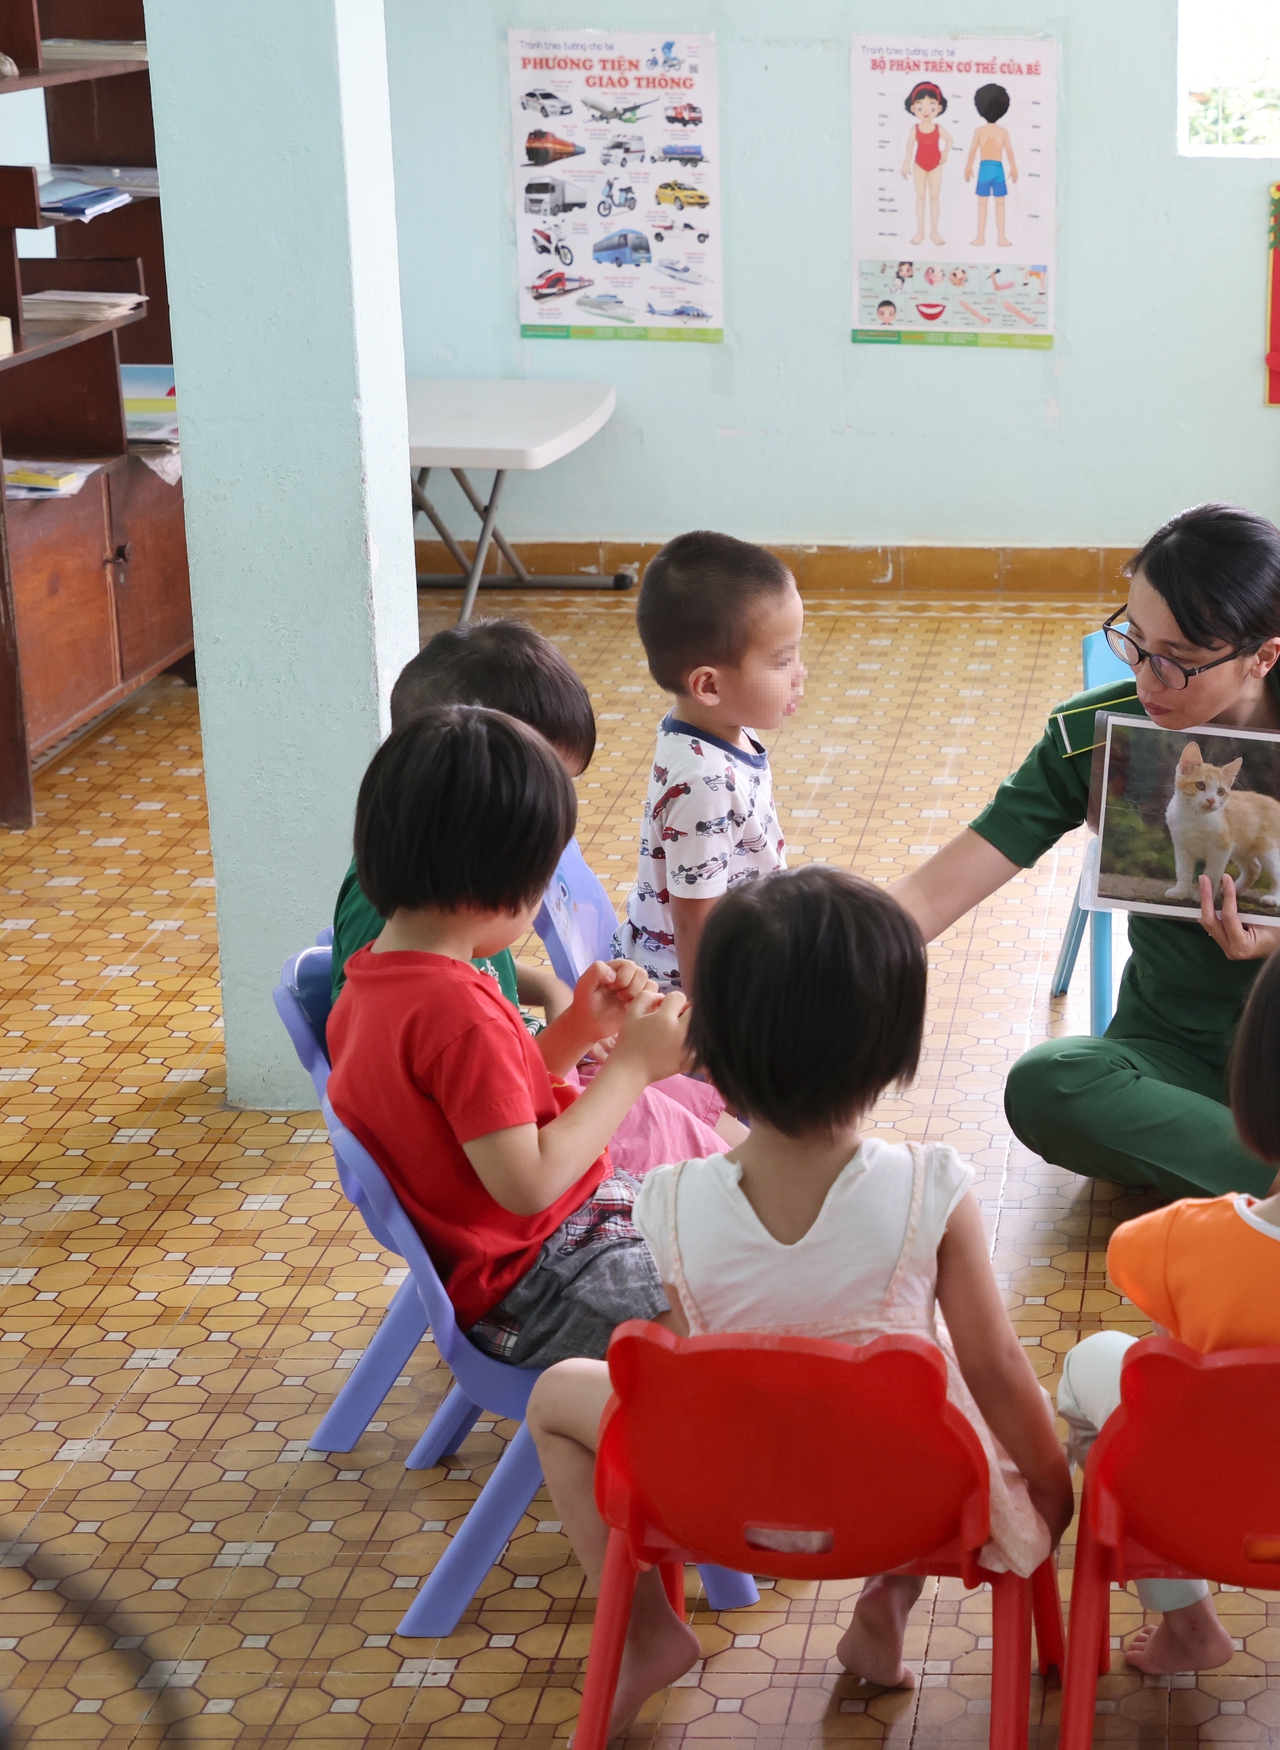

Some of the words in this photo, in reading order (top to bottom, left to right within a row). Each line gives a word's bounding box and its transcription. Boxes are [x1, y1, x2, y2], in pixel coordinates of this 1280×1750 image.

[521, 57, 594, 70] PHƯƠNG
[598, 56, 640, 73] TIỆN
[870, 56, 887, 74] BỘ
[889, 57, 921, 75] PHẬN
[923, 58, 954, 74] TRÊN
[634, 73, 695, 89] THÔNG
